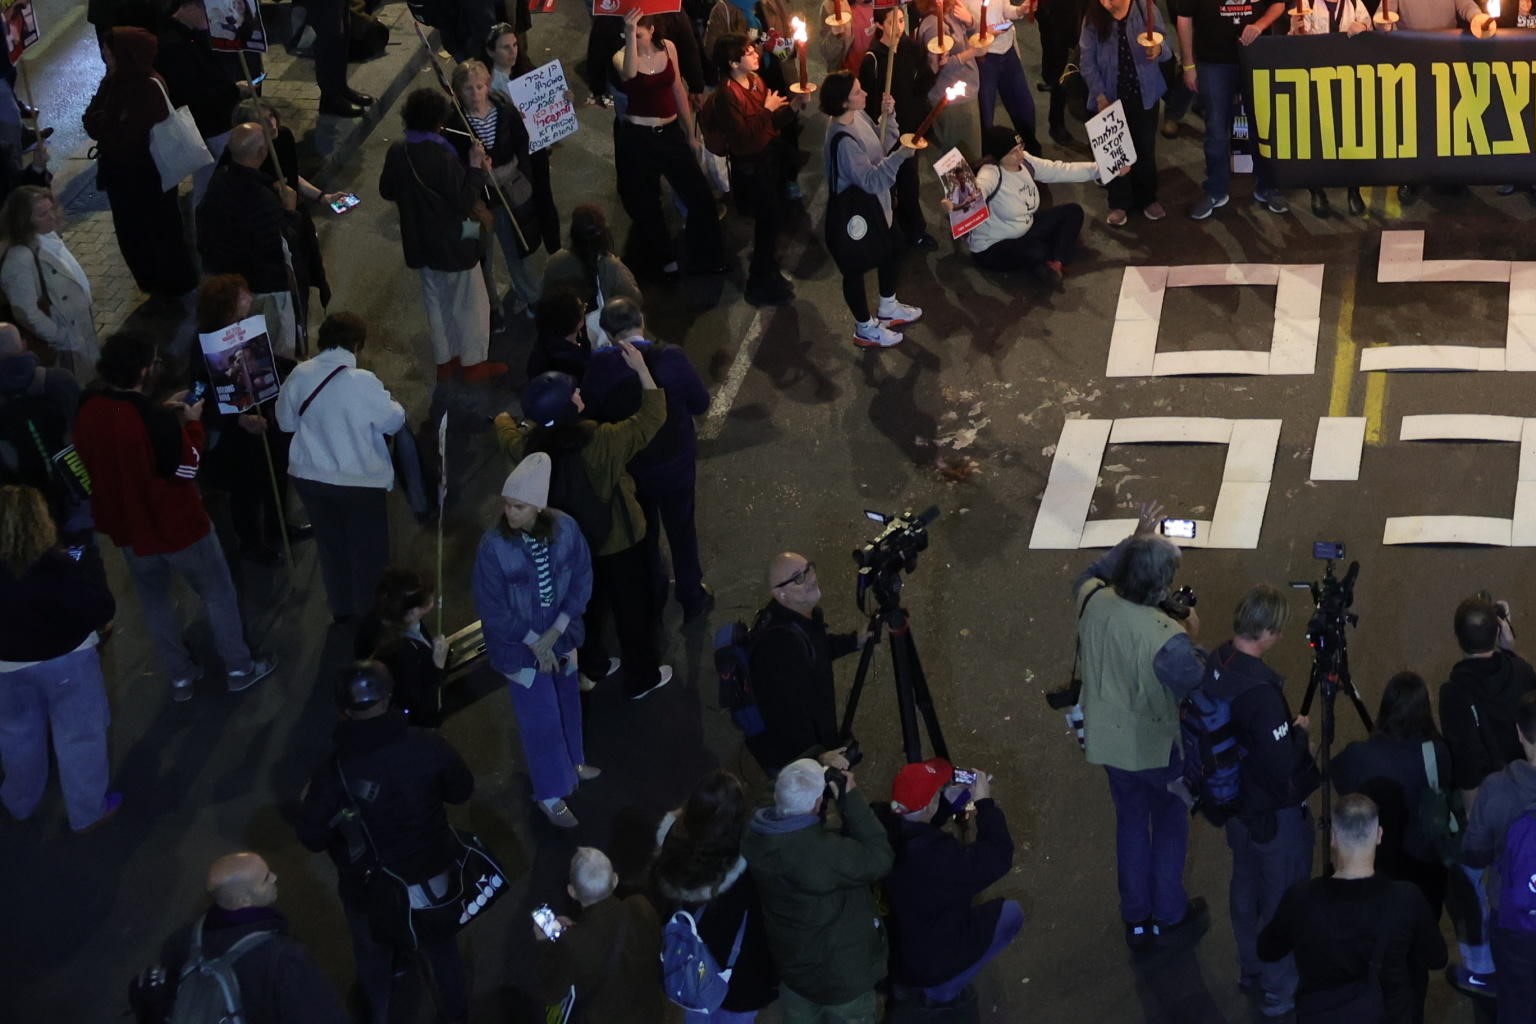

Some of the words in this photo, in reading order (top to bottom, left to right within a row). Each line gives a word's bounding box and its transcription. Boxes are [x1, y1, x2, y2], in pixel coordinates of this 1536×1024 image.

[1103, 110, 1116, 123] די
[1252, 62, 1419, 163] מעזה!
[1092, 119, 1125, 149] למלחמה
[1103, 132, 1125, 154] STOP
[1109, 148, 1125, 161] THE
[1107, 156, 1131, 176] WAR
[1272, 721, 1288, 741] HH
